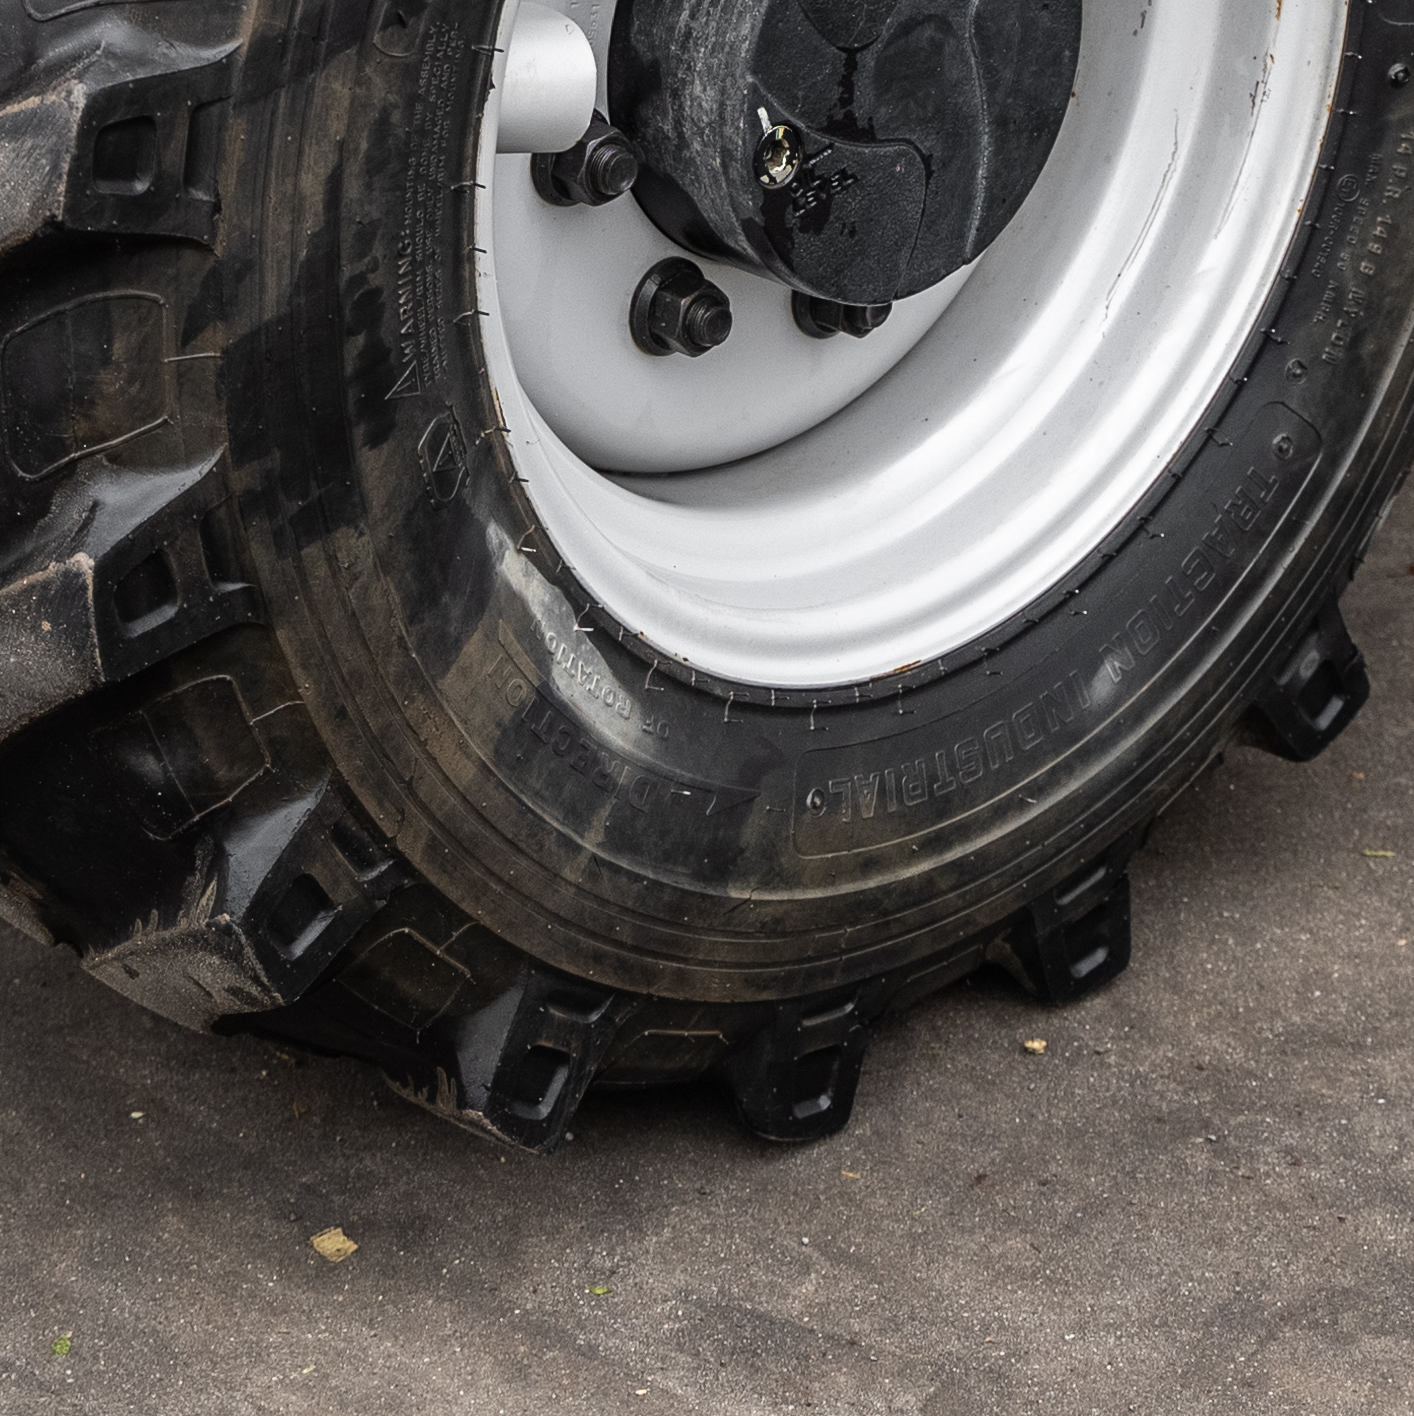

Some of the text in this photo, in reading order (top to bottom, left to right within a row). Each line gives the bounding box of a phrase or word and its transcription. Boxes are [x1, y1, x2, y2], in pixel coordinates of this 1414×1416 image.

[791, 168, 859, 218] LEVEL
[397, 227, 416, 363] WARNING:
[1098, 465, 1281, 683] TRACTION
[483, 652, 661, 812] DIRECTION
[529, 616, 635, 720] ROTATION
[827, 669, 1092, 823] INDUSTRIAL
